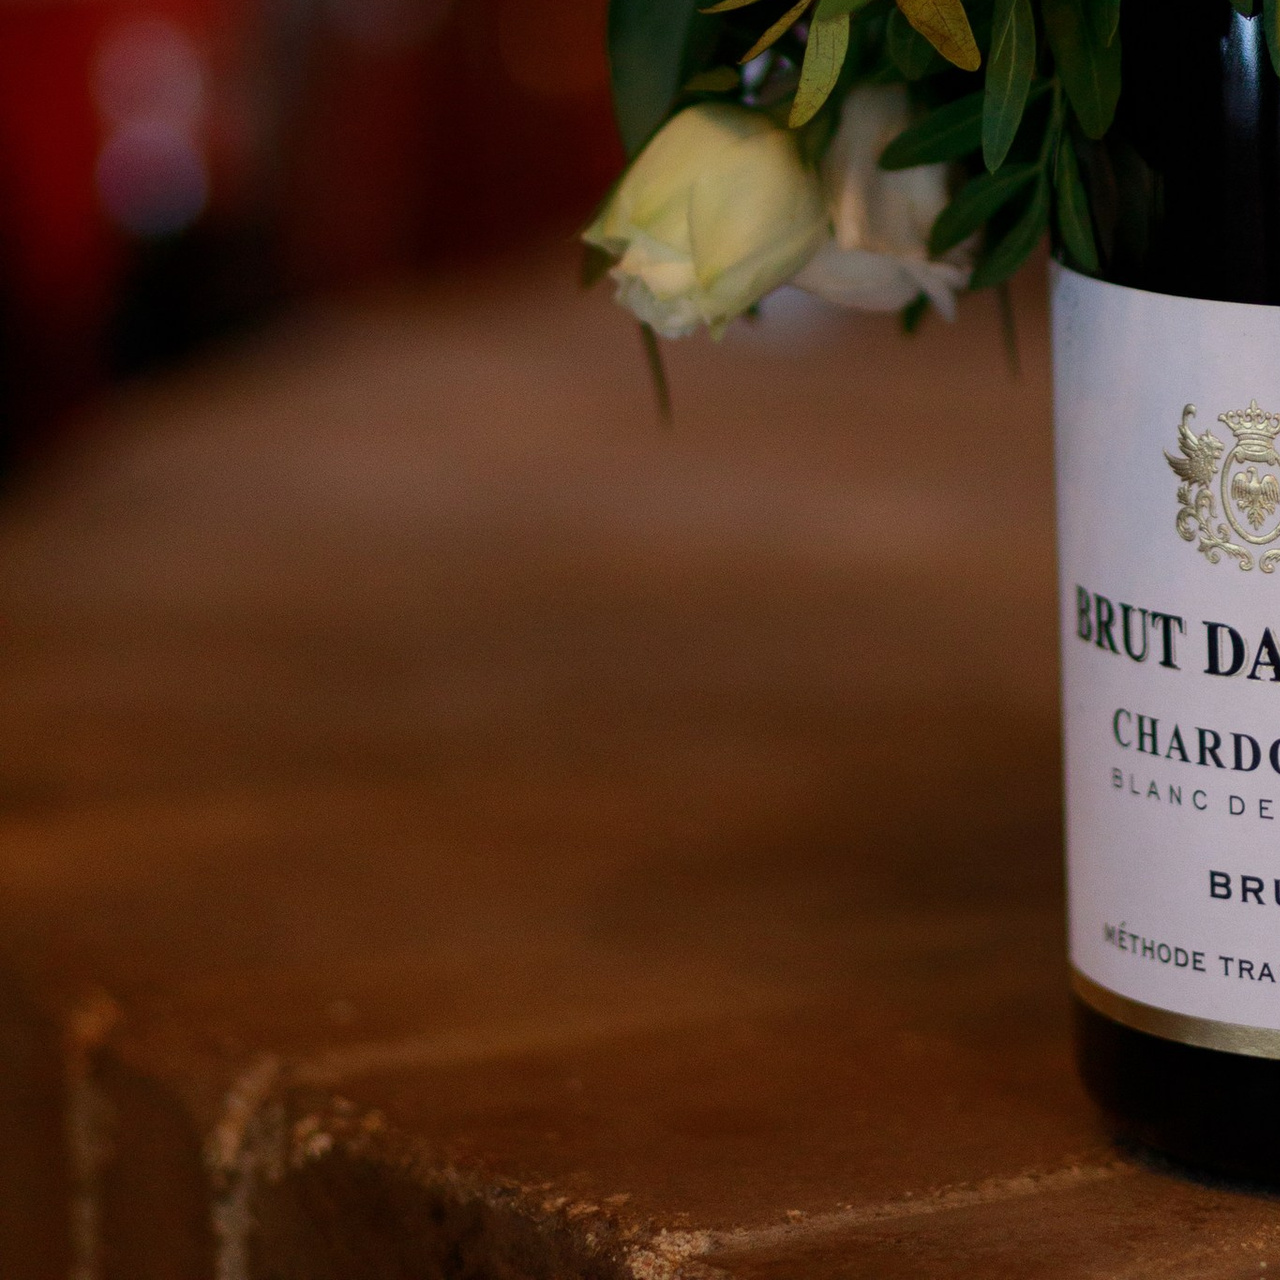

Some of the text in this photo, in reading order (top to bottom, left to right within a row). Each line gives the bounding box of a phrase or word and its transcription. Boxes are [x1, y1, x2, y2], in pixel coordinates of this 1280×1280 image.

[1076, 585, 1184, 671] BRUT
[1113, 768, 1210, 811] BLANC
[1229, 795, 1274, 820] DE
[1105, 925, 1206, 972] MÉTHODE
